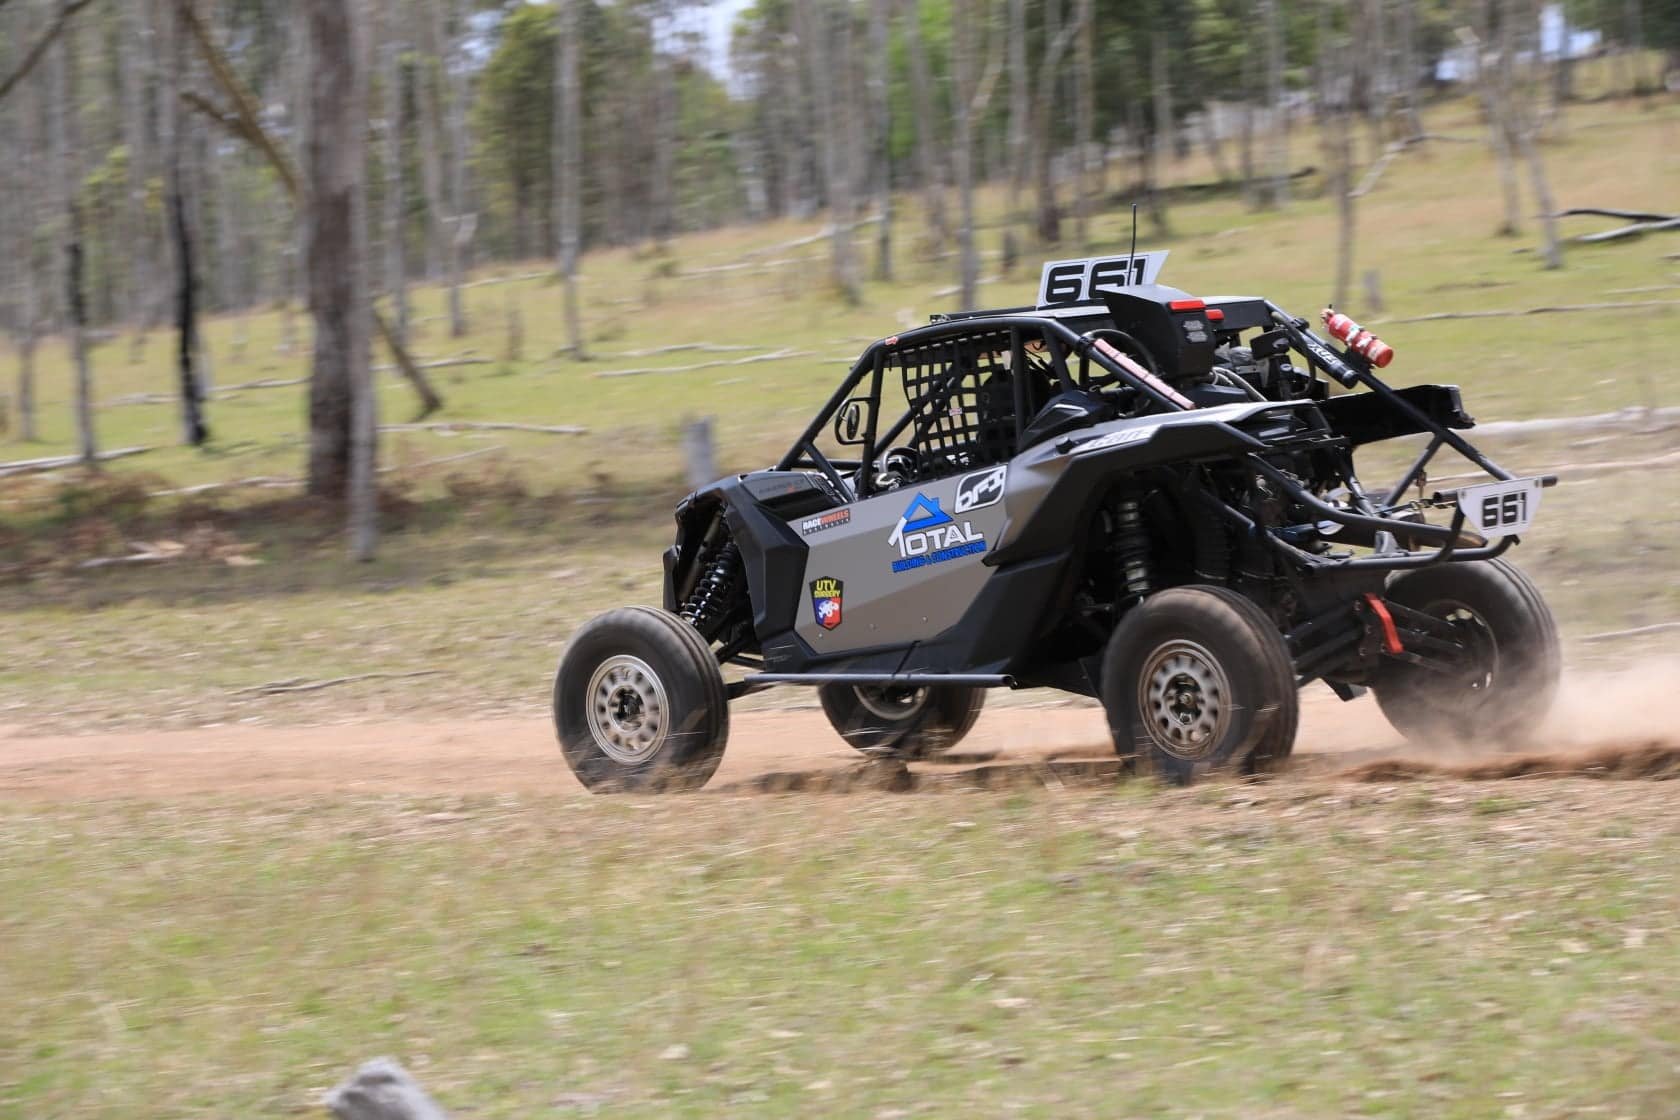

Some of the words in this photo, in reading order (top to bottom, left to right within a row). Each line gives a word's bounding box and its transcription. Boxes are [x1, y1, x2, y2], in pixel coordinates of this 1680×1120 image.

[1046, 258, 1146, 303] 661
[1482, 492, 1527, 527] 661
[888, 517, 984, 558] TOTAL
[816, 580, 836, 591] UTV
